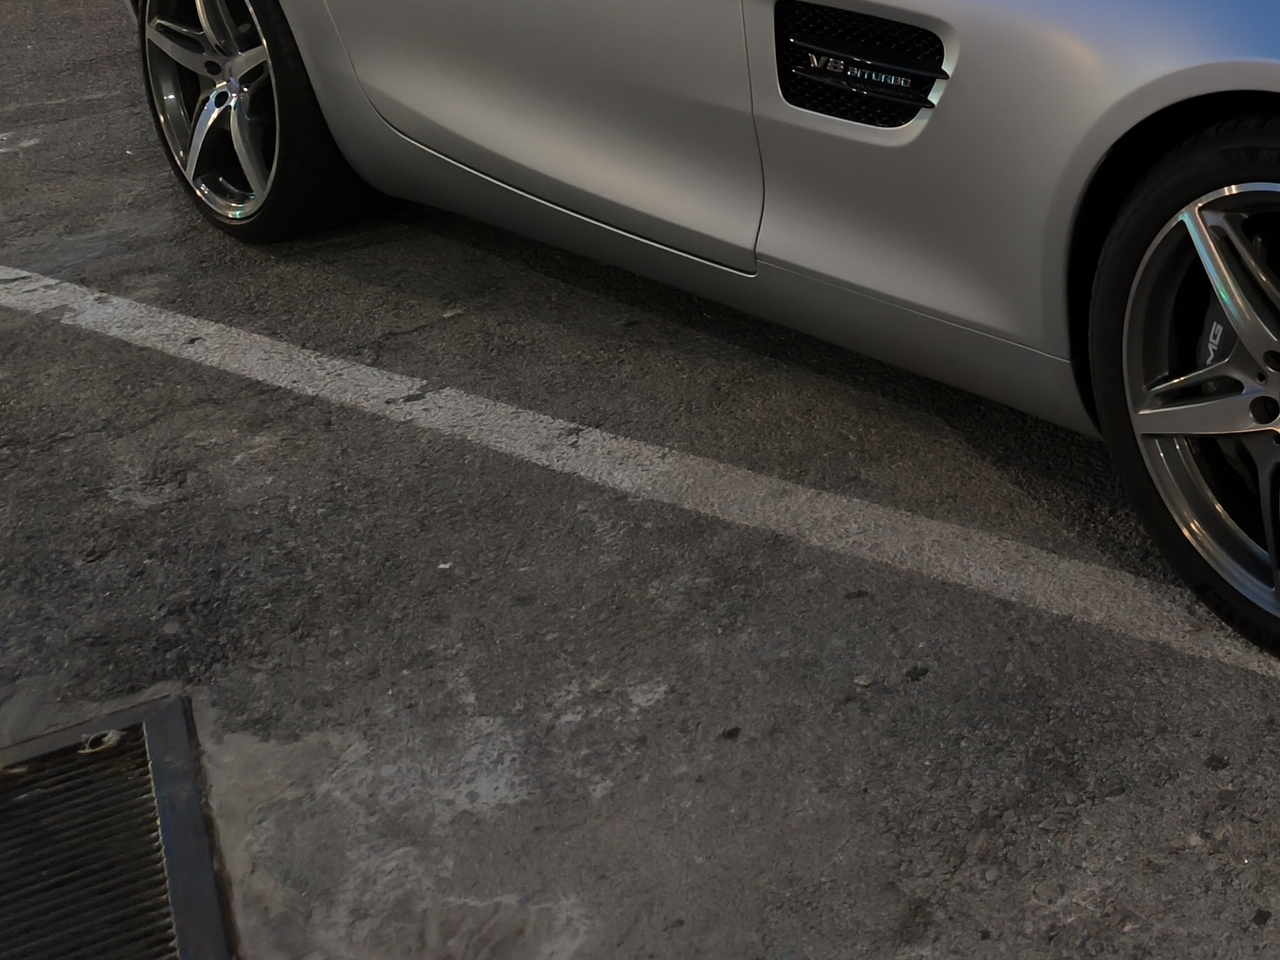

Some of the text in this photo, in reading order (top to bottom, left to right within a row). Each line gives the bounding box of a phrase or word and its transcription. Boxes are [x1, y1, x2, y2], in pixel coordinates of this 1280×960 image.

[808, 52, 912, 88] V8 BITURBO
[1206, 321, 1224, 366] MG
